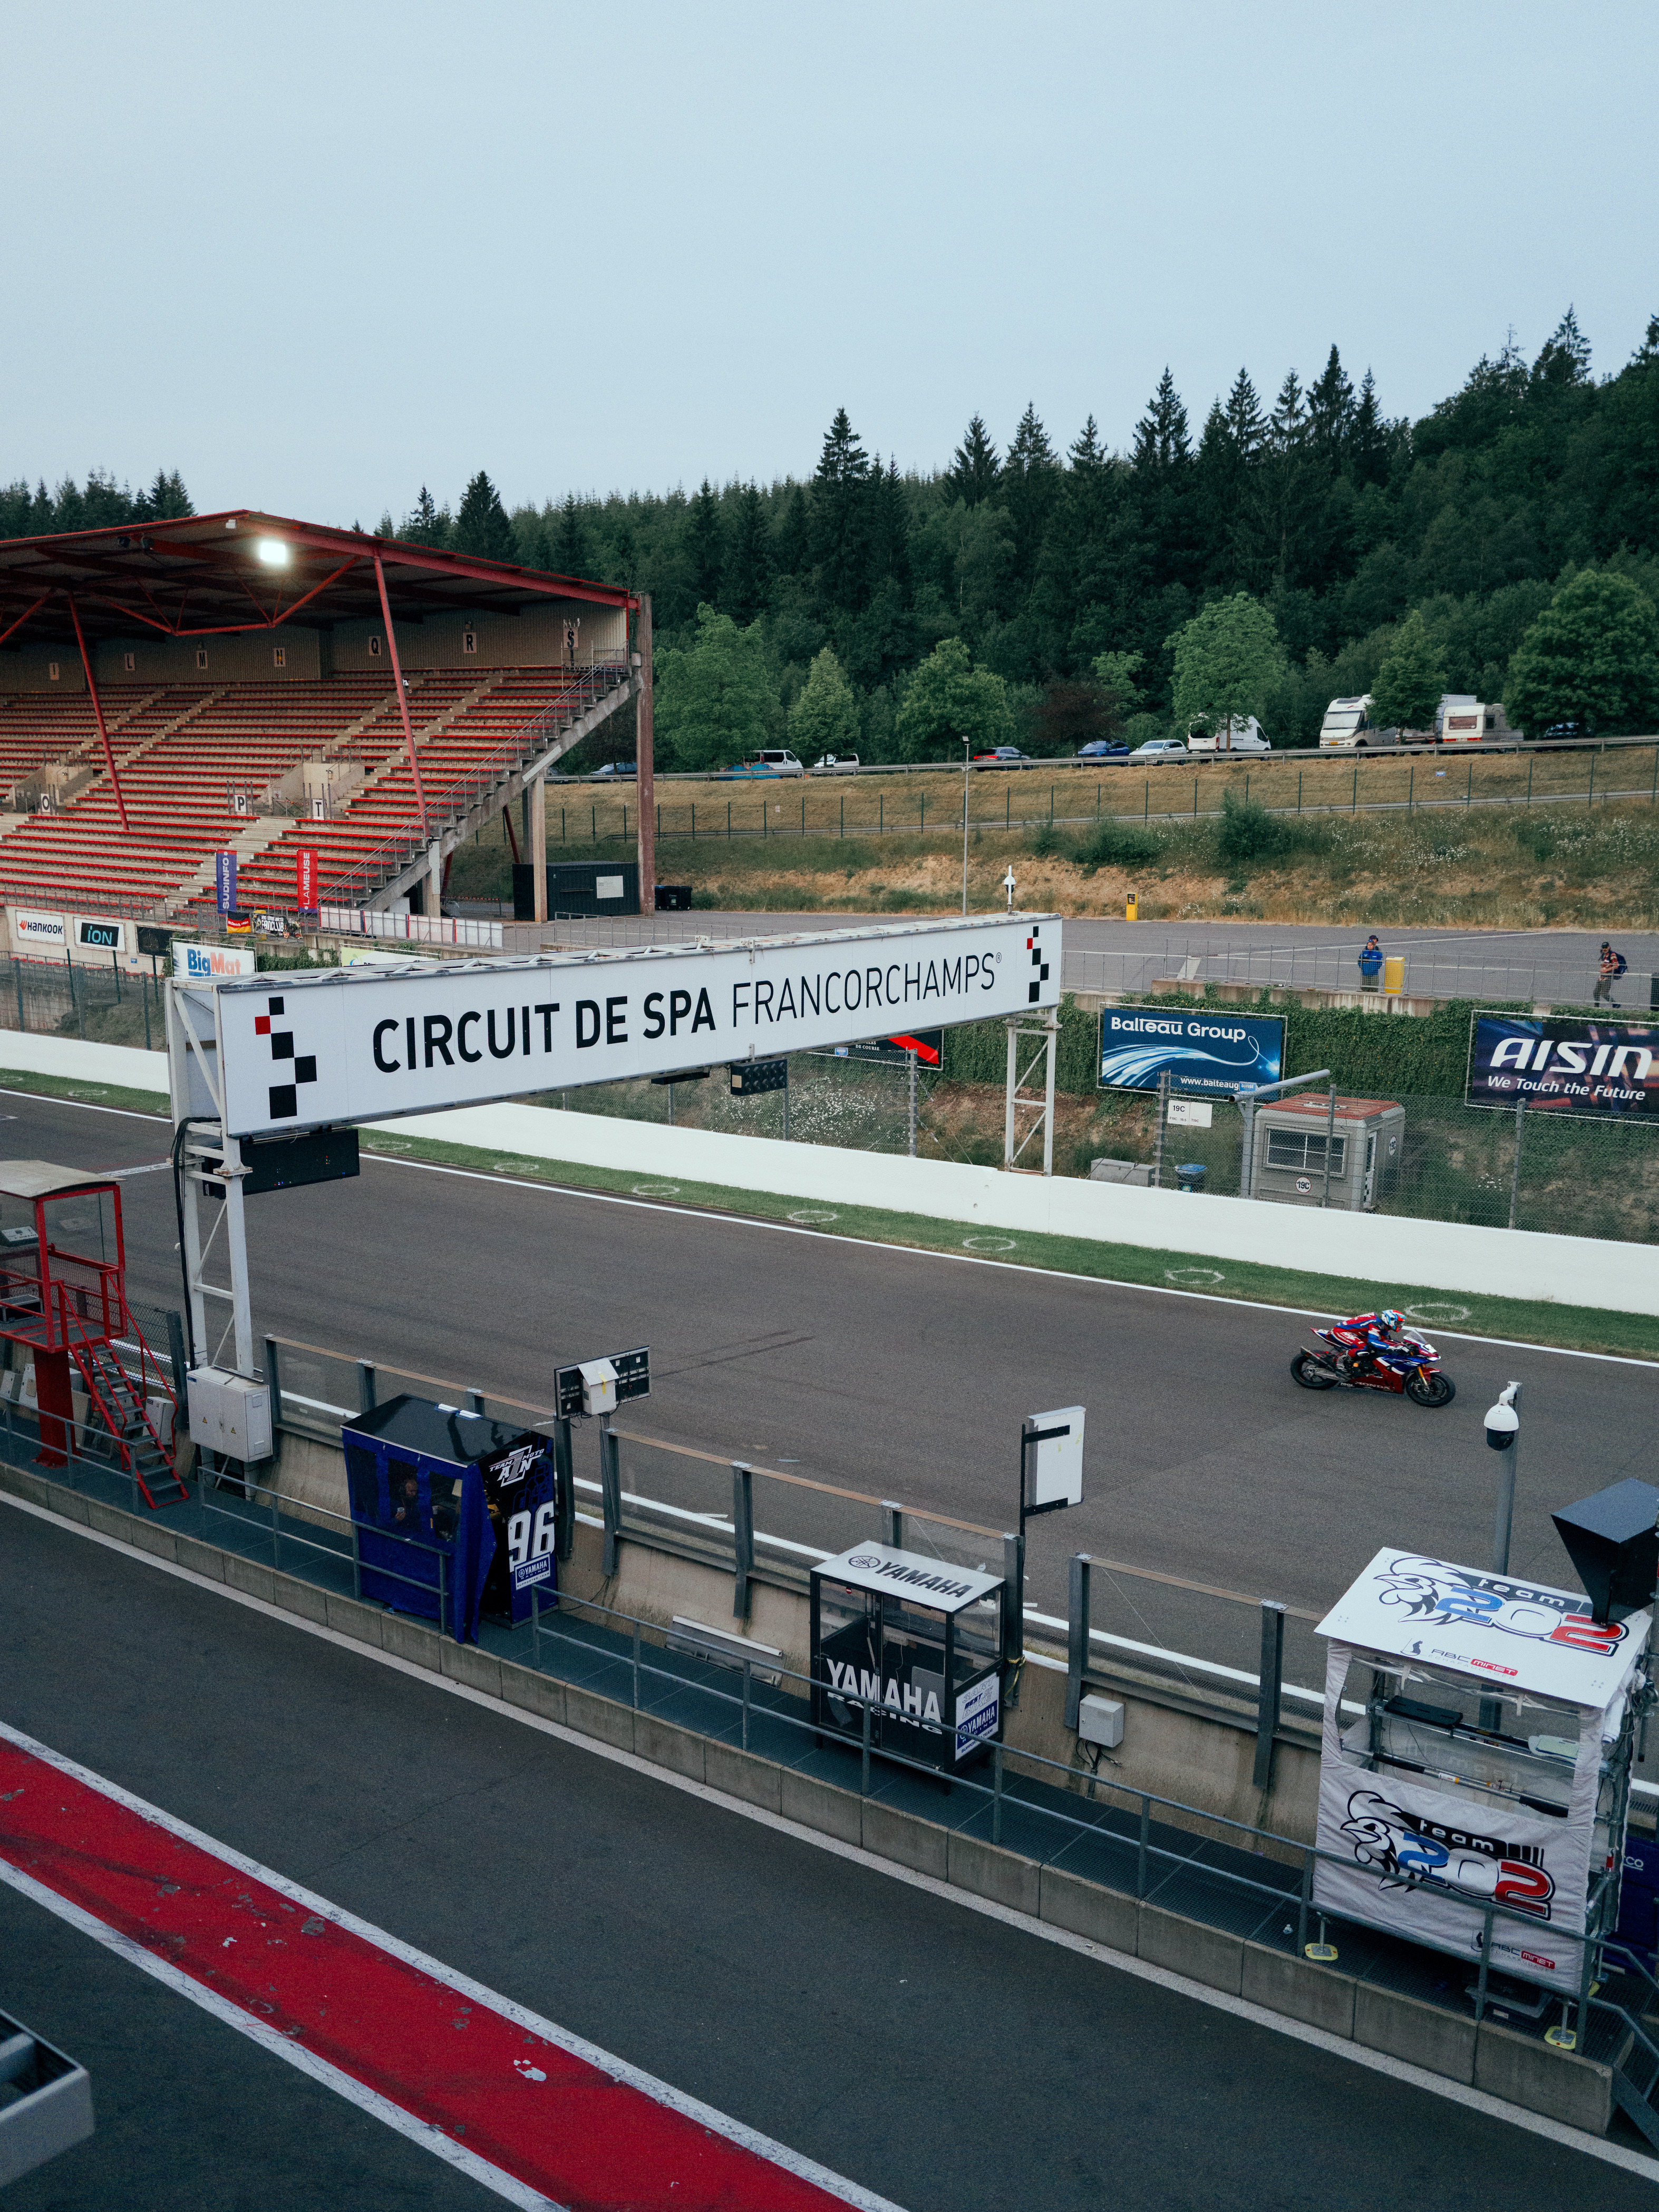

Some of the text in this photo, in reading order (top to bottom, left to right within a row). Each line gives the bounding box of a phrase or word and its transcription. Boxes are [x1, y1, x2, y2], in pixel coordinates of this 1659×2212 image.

[371, 638, 379, 655] Q
[466, 634, 473, 651] R
[567, 630, 574, 648] S
[127, 655, 133, 669] L
[199, 652, 205, 667] M
[276, 649, 283, 665] N
[42, 795, 50, 810] O
[237, 796, 245, 811] P
[315, 802, 322, 817] T
[261, 920, 284, 932] FANCLUB
[187, 948, 241, 976] BigMat
[373, 1003, 560, 1073] CIRCUIT
[576, 996, 628, 1049] DE
[643, 987, 716, 1040] SPA
[1111, 1017, 1246, 1043] Balteau Group
[1490, 1037, 1653, 1080] AISIN
[1180, 1077, 1239, 1091] www.balteaug
[1488, 1075, 1646, 1101] We Touch the Future
[1297, 1181, 1309, 1189] 19C
[489, 1449, 545, 1472] TEAM MOTO
[508, 1500, 555, 1573] 96
[521, 1568, 546, 1580] RACING
[525, 1560, 547, 1575] YAMAHA
[517, 1577, 538, 1588] SUPPORTED
[875, 1561, 974, 1598] YAMAHA
[1478, 1578, 1565, 1607] team
[1434, 1586, 1629, 1657] 202
[1431, 1648, 1471, 1663] ABC
[826, 1658, 942, 1724] YAMAHA
[964, 1693, 983, 1710] BEST
[827, 1691, 943, 1735] RACING
[968, 1706, 995, 1733] YAMAHA
[1420, 1820, 1494, 1852] team
[1398, 1831, 1556, 1921] 202
[1491, 1942, 1521, 1956] ABC
